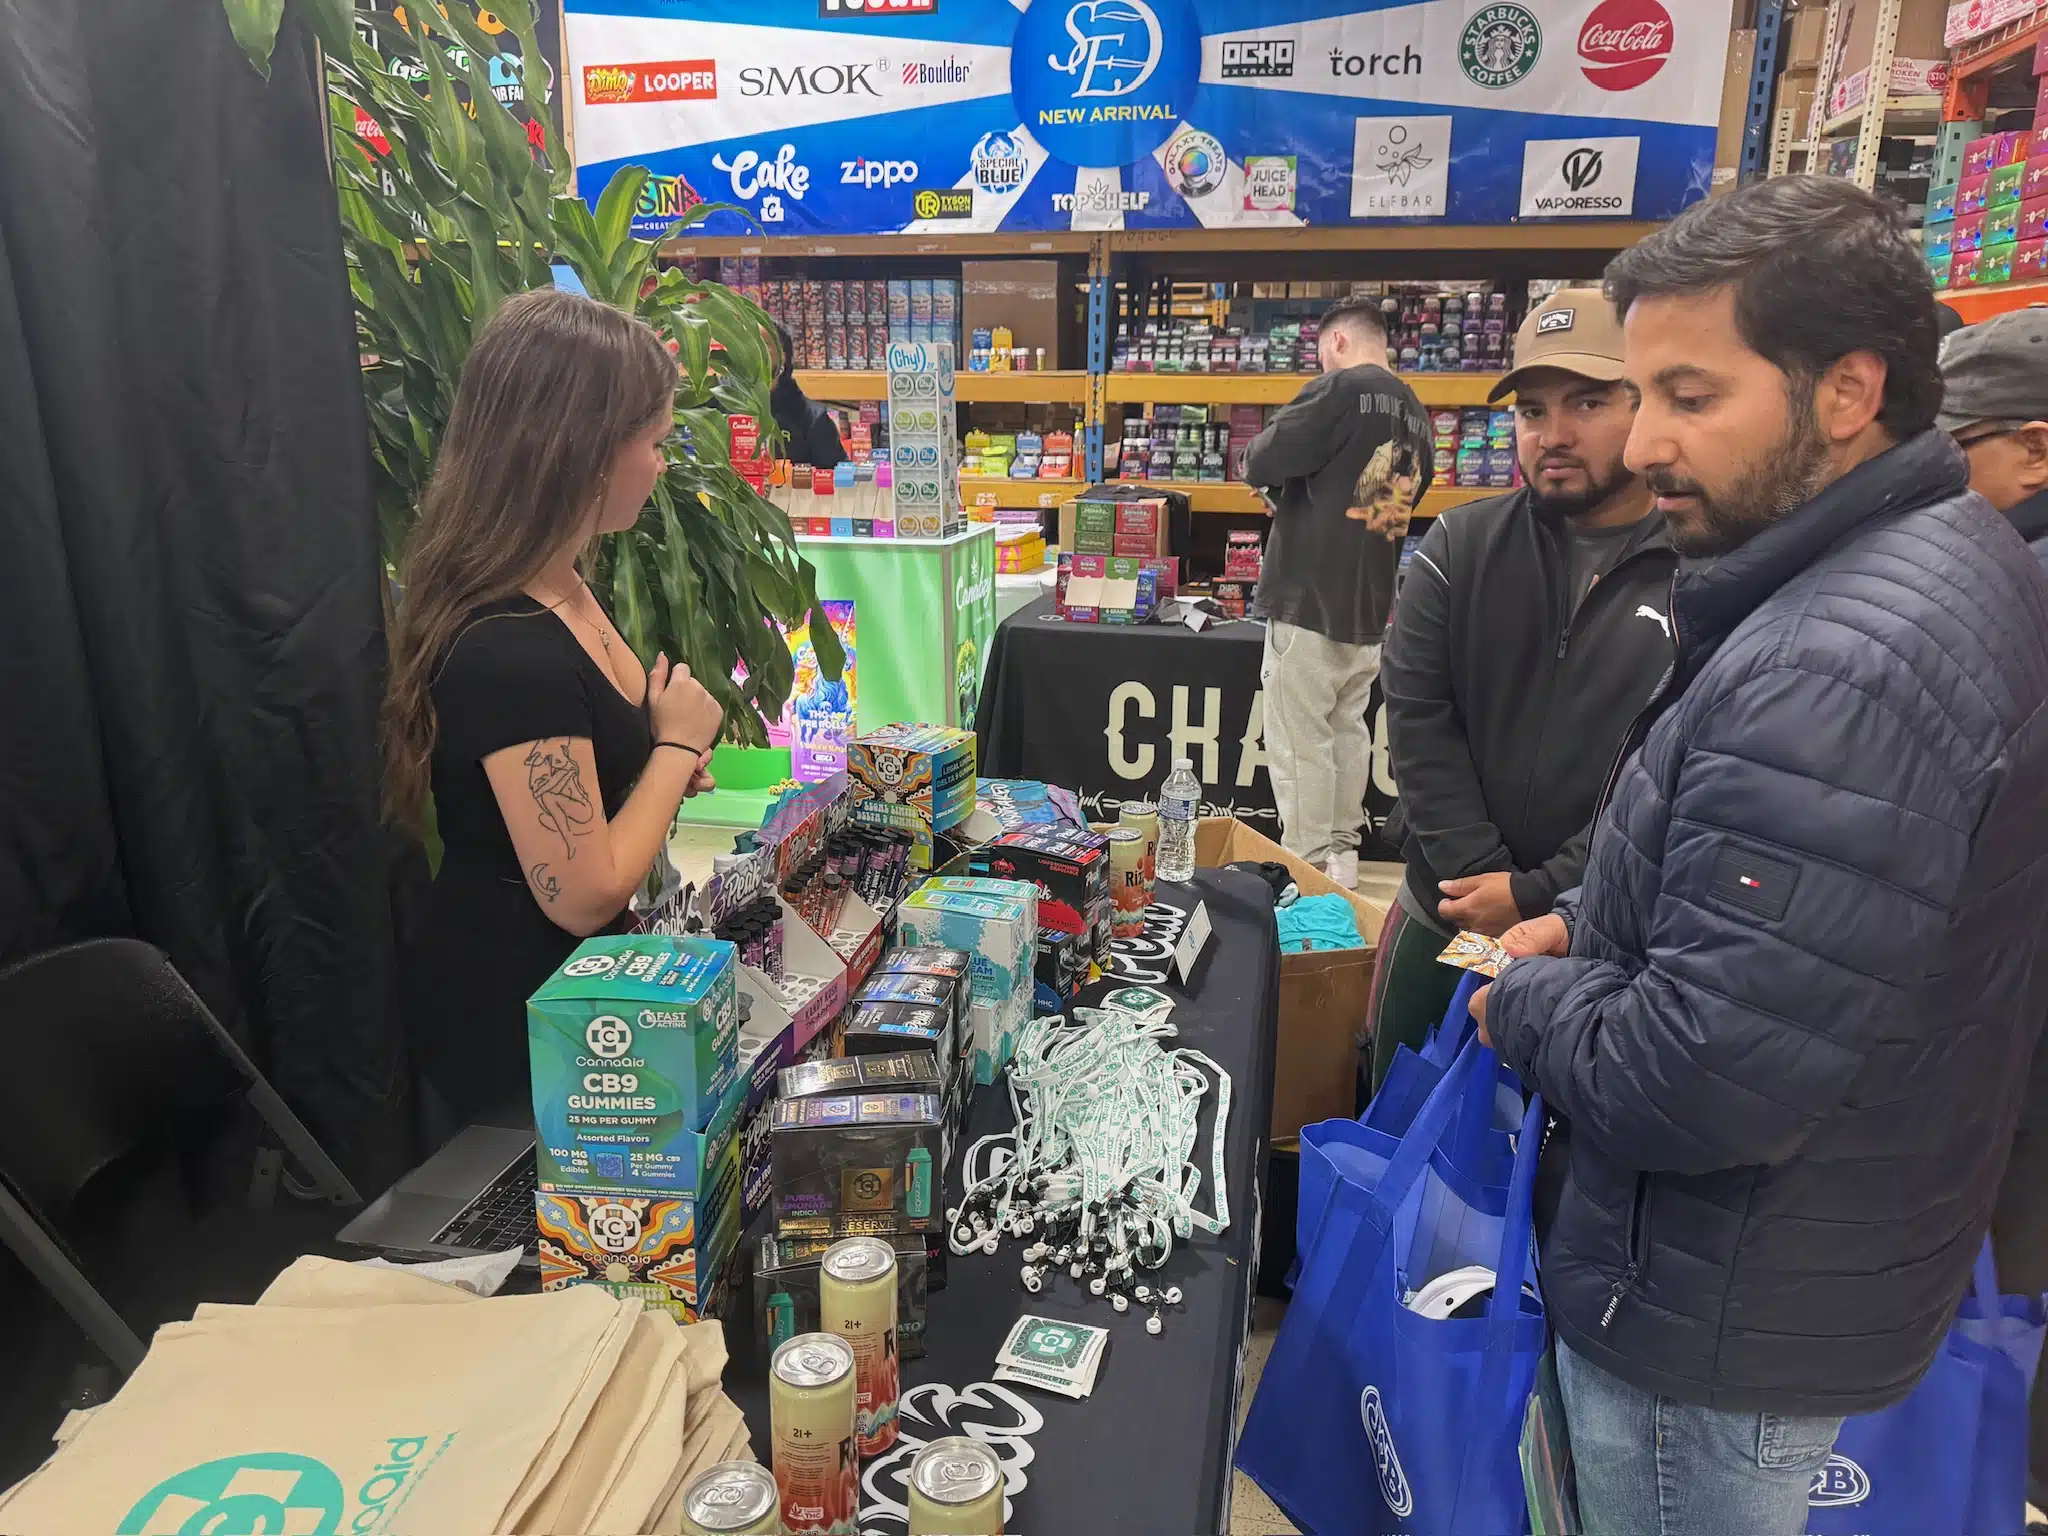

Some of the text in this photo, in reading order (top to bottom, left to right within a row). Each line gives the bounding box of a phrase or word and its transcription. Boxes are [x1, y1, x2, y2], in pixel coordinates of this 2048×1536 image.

[1465, 4, 1537, 46] STARBUCKS
[1581, 19, 1670, 54] Coca-Cola
[1223, 40, 1294, 69] OCHO
[1329, 44, 1423, 77] torch
[919, 54, 970, 84] Boulder
[1223, 67, 1293, 77] EXTRACTS
[1469, 64, 1523, 86] COFFEE
[644, 71, 715, 92] LOOPER
[1039, 104, 1178, 126] NEW ARRIVAL
[1168, 135, 1222, 175] GALAXY TREATS
[980, 158, 1020, 169] SPECIAL
[712, 144, 811, 201] Cake
[839, 156, 919, 189] zippo
[980, 168, 1020, 184] BLUE
[1253, 169, 1287, 182] JUICE
[1253, 185, 1286, 197] HEAD
[941, 194, 971, 206] TYSON
[941, 203, 971, 212] RANCH
[1052, 191, 1150, 213] TOP SHELF
[1535, 196, 1623, 211] VAPORESSO
[1374, 393, 1389, 414] YOU
[624, 954, 654, 977] CB9
[640, 951, 672, 983] GUMMIES
[657, 1011, 687, 1021] FAST
[583, 1072, 638, 1094] CB9
[567, 1095, 657, 1111] GUMMIES
[568, 1115, 658, 1126] 25 MG PER GUMMY
[576, 1133, 651, 1144] Assorted Flavors
[549, 1148, 588, 1159] 100 MG
[629, 1153, 681, 1163] 25 MG CB9
[560, 1165, 590, 1175] Edibles
[571, 1158, 589, 1167] CB9
[630, 1162, 674, 1173] Per Gummy
[631, 1169, 677, 1180] 4 Gummies
[784, 1194, 825, 1202] PURPLE
[840, 1220, 894, 1231] RESERVE
[1600, 1295, 1619, 1328] HILFIGER
[844, 1319, 861, 1330] 21+
[793, 1428, 812, 1438] 21+
